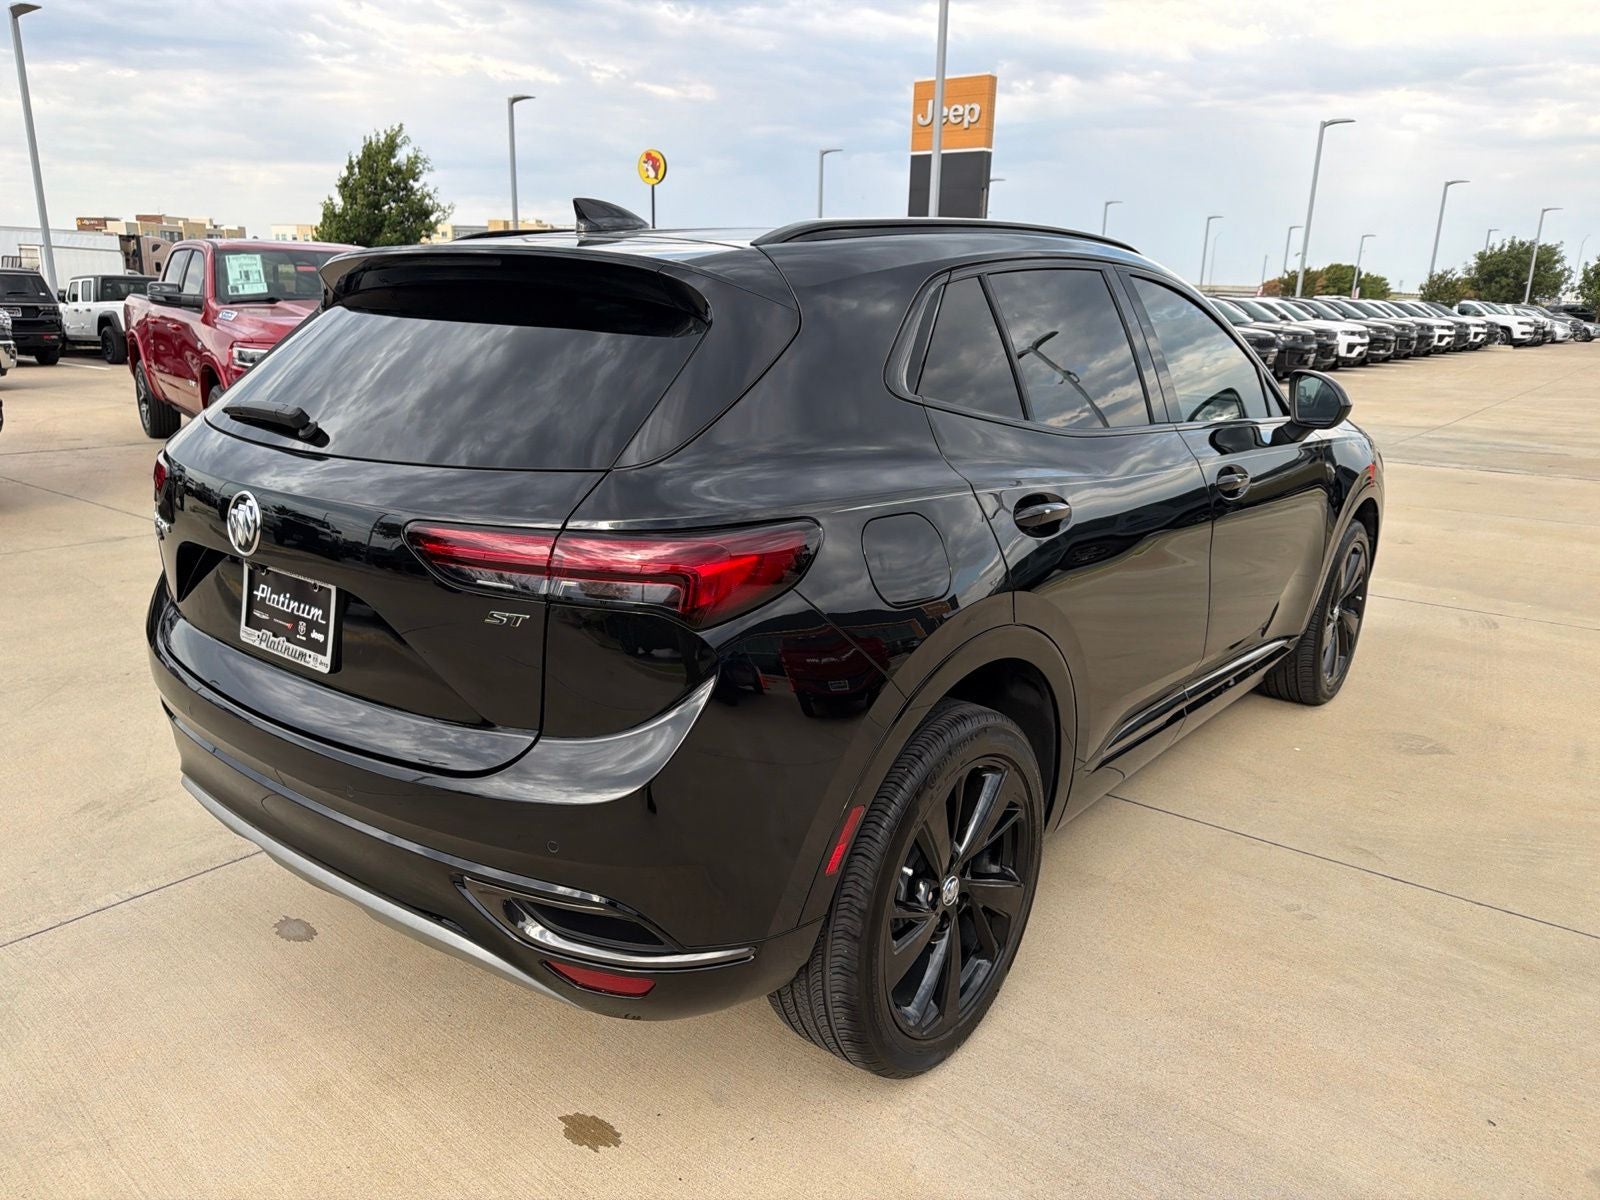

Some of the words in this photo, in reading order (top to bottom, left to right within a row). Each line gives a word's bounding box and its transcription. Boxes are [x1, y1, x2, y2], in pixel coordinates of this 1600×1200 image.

[253, 584, 327, 624] Platinum
[484, 610, 531, 628] ST
[259, 631, 311, 664] Platinum
